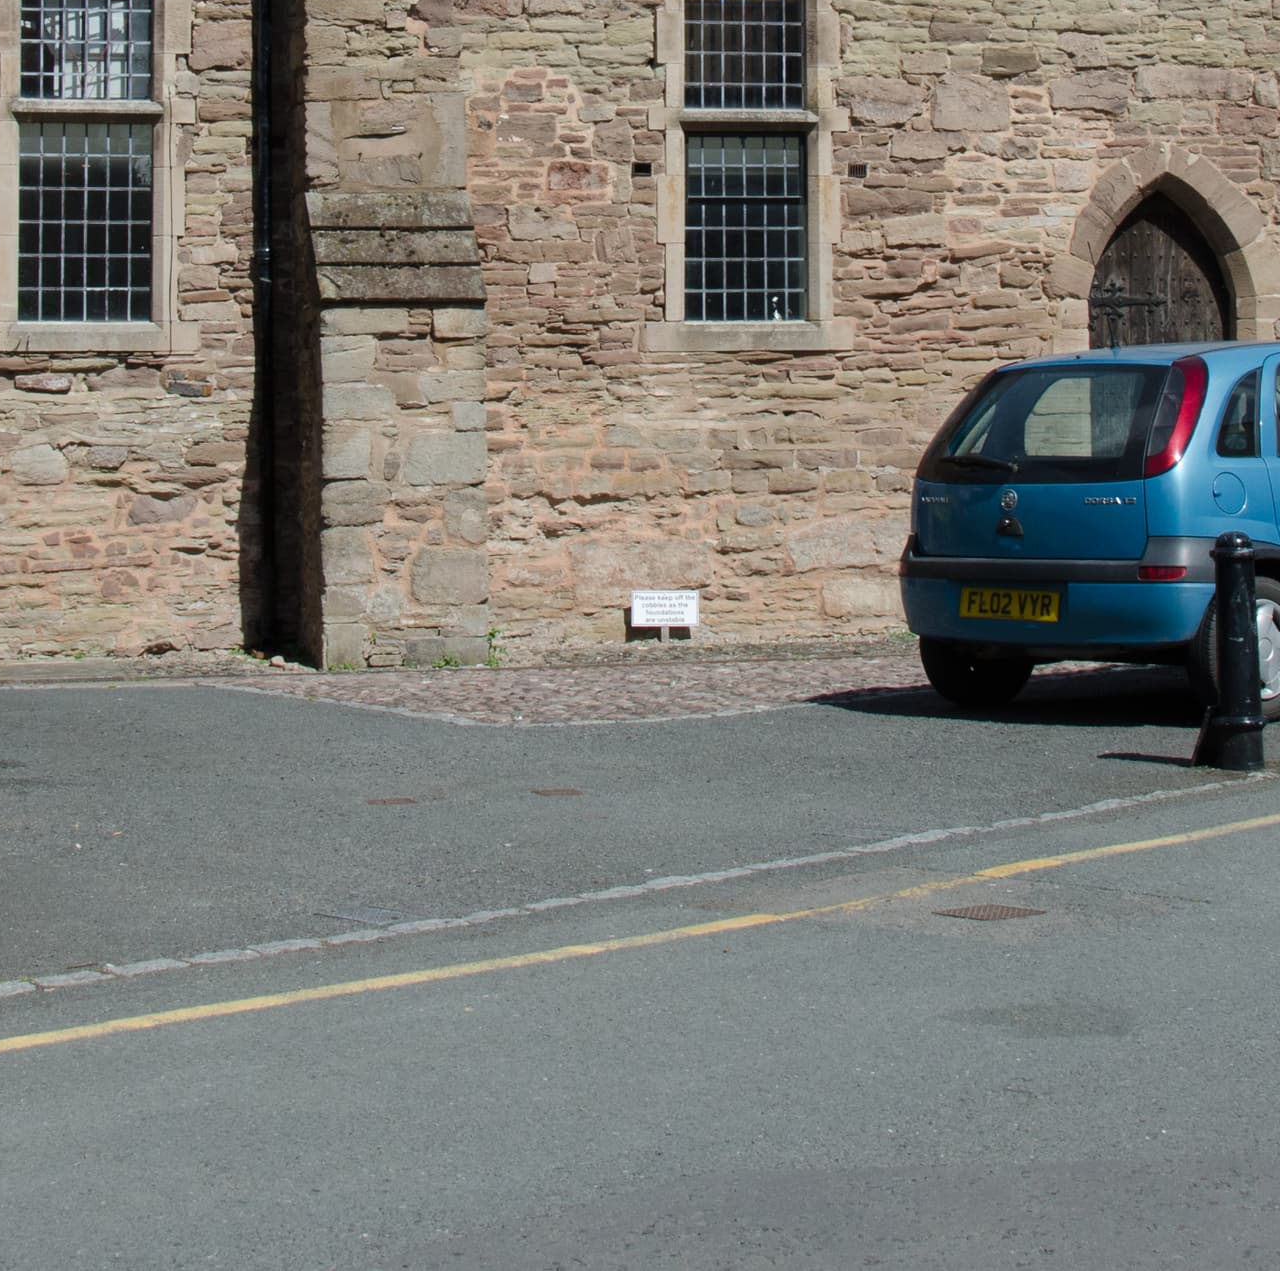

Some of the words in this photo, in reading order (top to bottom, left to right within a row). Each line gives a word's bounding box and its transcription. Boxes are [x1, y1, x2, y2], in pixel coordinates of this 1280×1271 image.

[658, 594, 673, 602] keep
[967, 590, 1013, 615] FL02
[1018, 592, 1053, 617] VYR
